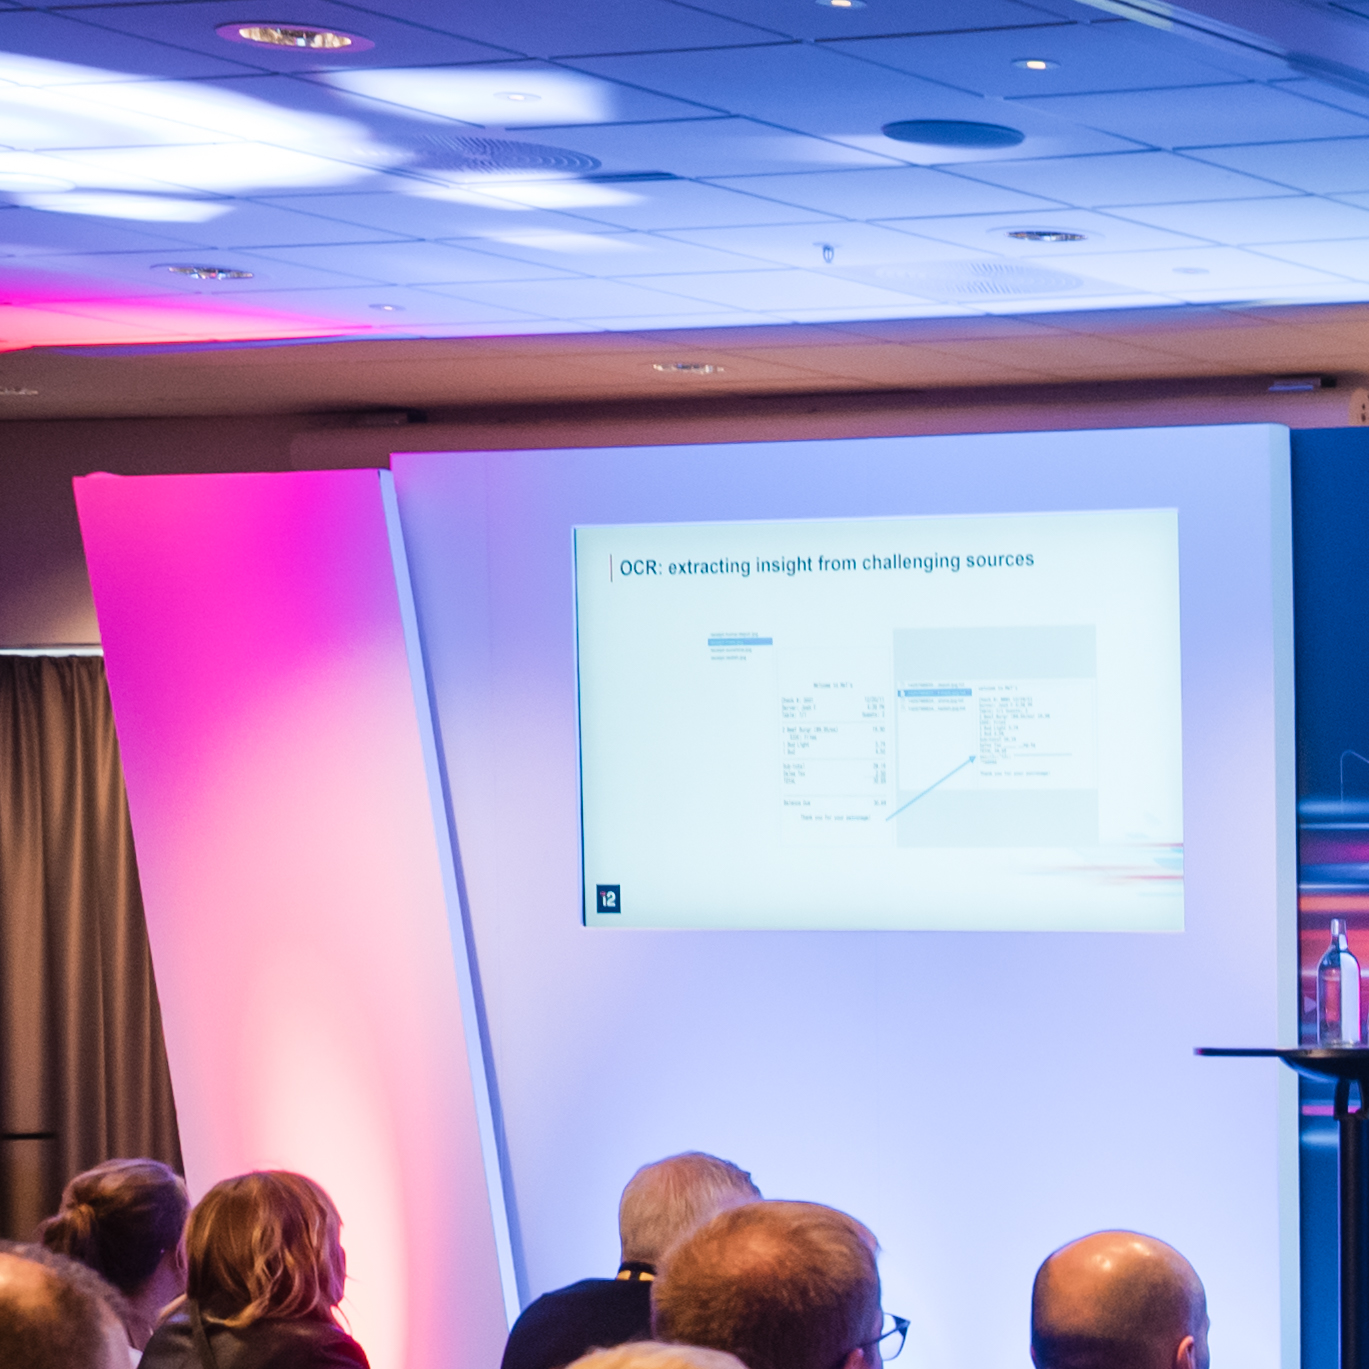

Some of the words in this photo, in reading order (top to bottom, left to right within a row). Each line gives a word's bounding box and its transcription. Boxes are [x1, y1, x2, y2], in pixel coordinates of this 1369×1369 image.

[620, 559, 662, 576] OCR:
[668, 559, 751, 578] extracting
[756, 556, 812, 576] insight
[818, 555, 857, 571] from
[862, 552, 961, 573] challenging
[966, 554, 1035, 568] sources
